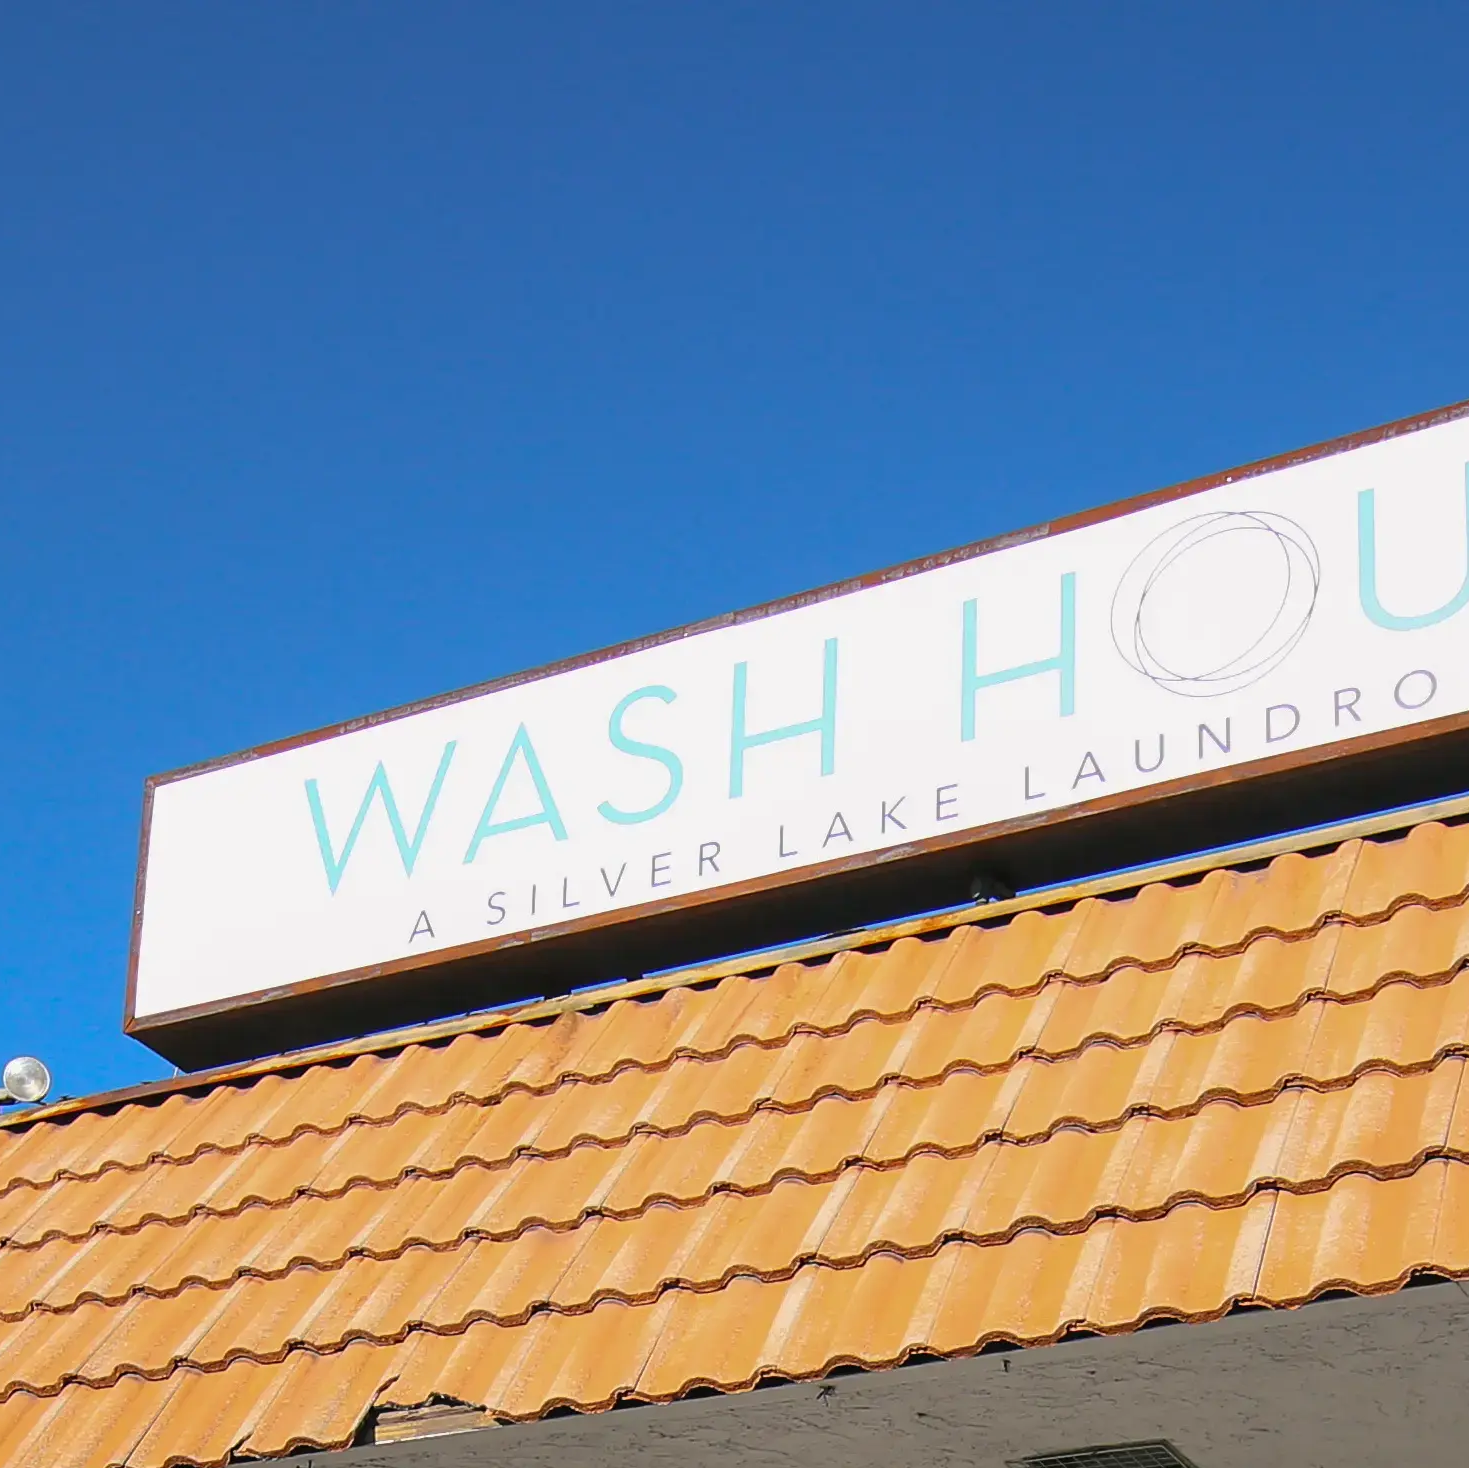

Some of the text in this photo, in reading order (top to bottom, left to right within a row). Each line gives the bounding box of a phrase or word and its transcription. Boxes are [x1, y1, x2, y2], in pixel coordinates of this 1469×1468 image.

[304, 636, 836, 897] WASH
[407, 908, 438, 945] A
[483, 839, 724, 931] SILVER
[778, 786, 961, 862] LAKE
